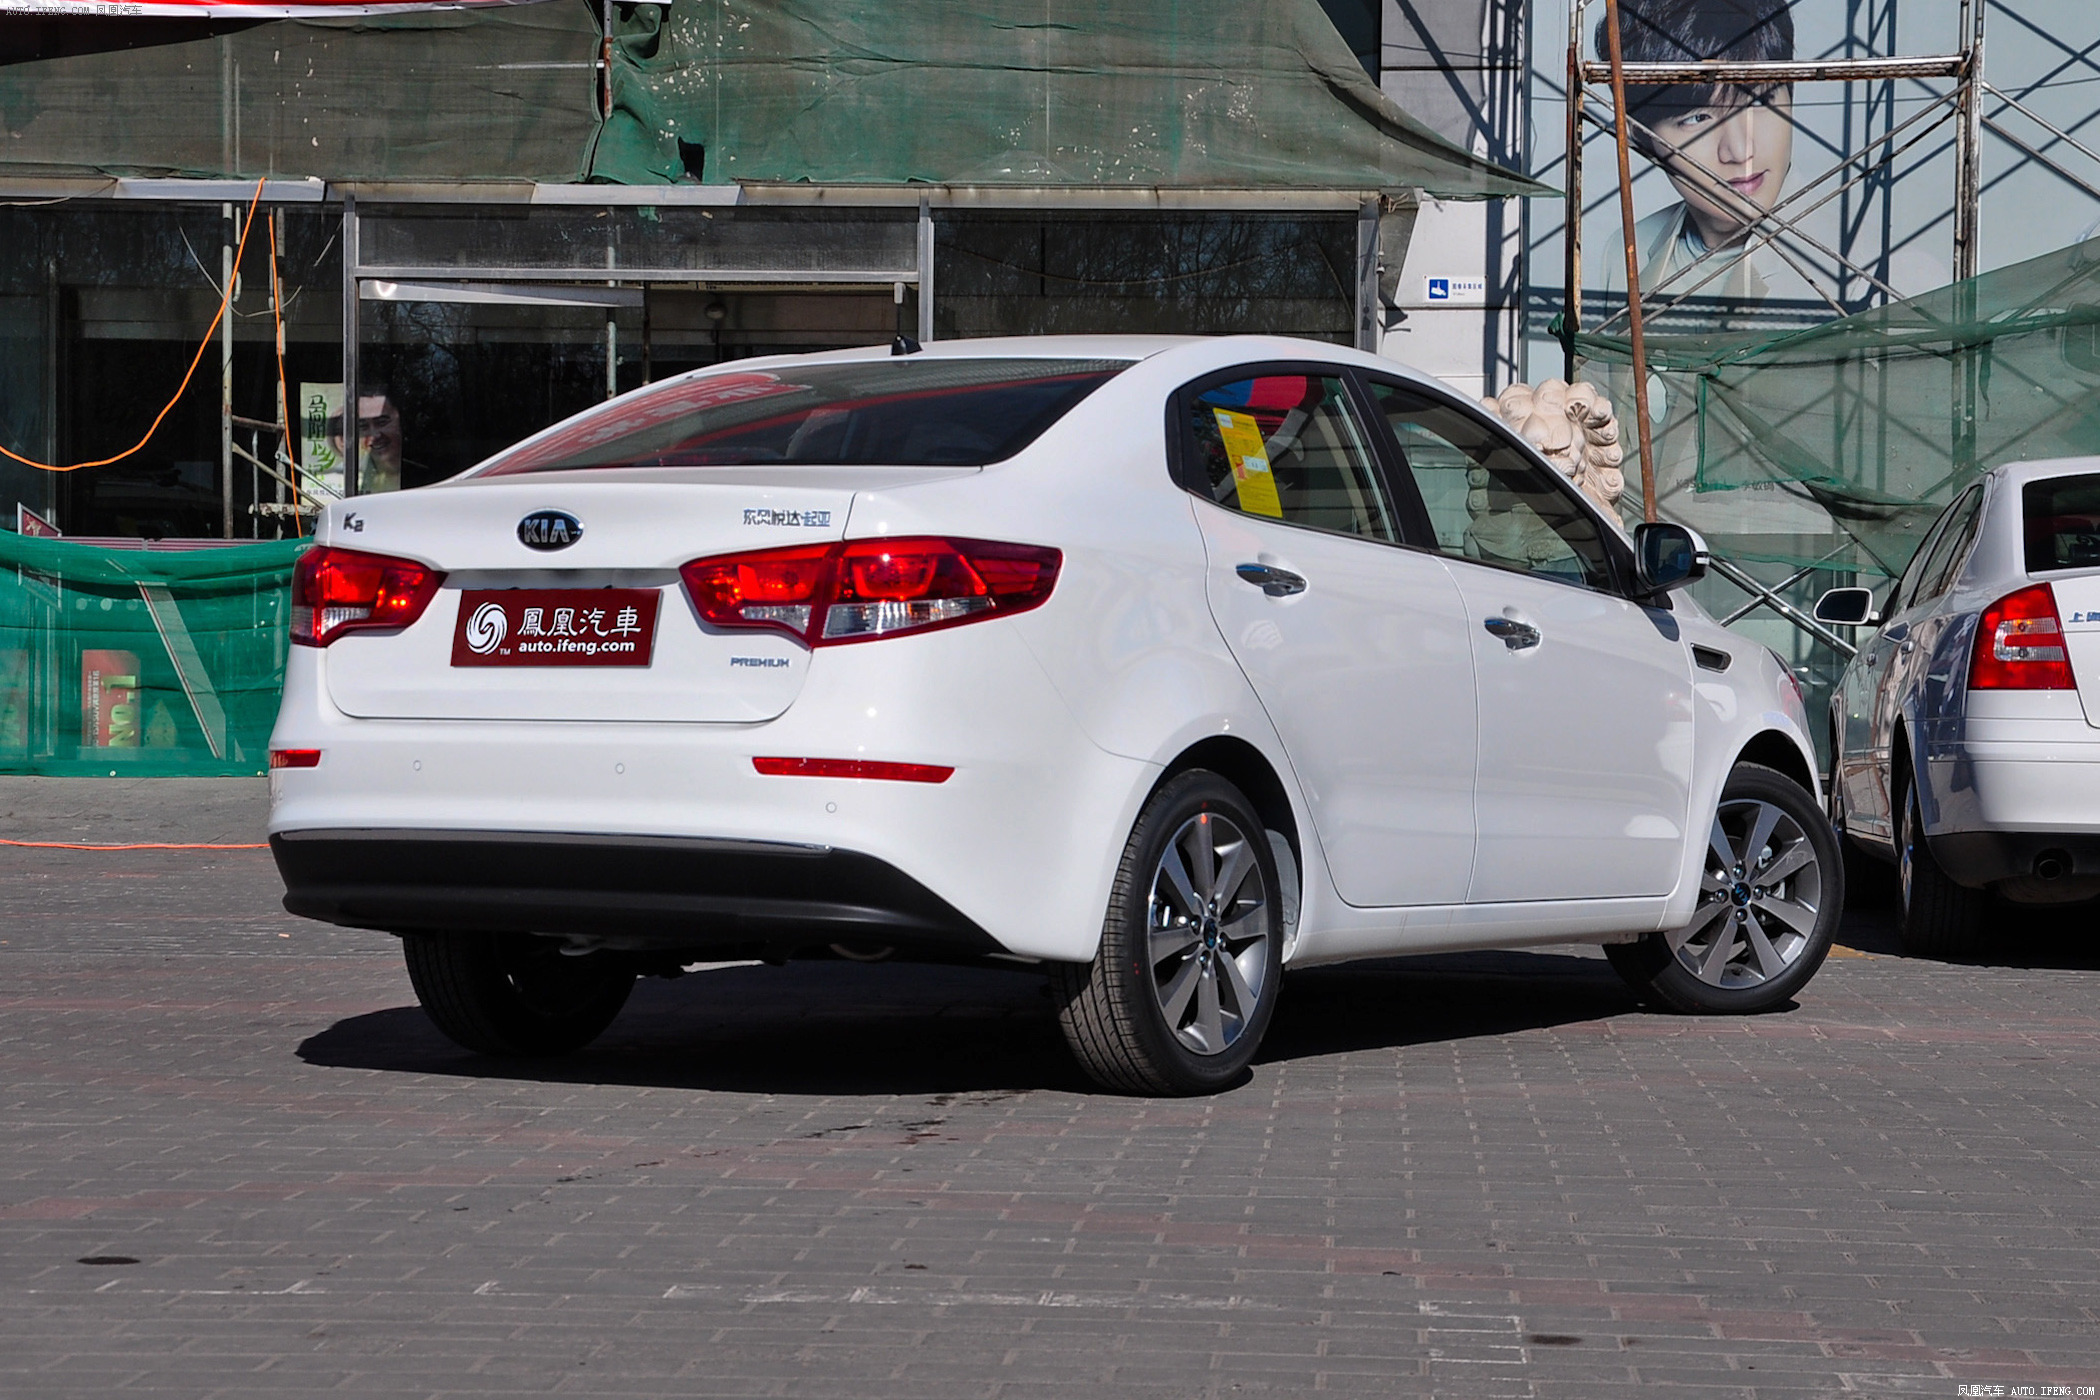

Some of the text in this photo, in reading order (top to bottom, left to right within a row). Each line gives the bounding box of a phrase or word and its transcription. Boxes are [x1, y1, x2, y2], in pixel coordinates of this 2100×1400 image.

[524, 518, 571, 544] KIA
[517, 605, 642, 638] 鳳凰汽車
[518, 639, 636, 656] auto.ifeng.com
[730, 657, 790, 668] PREMIUM
